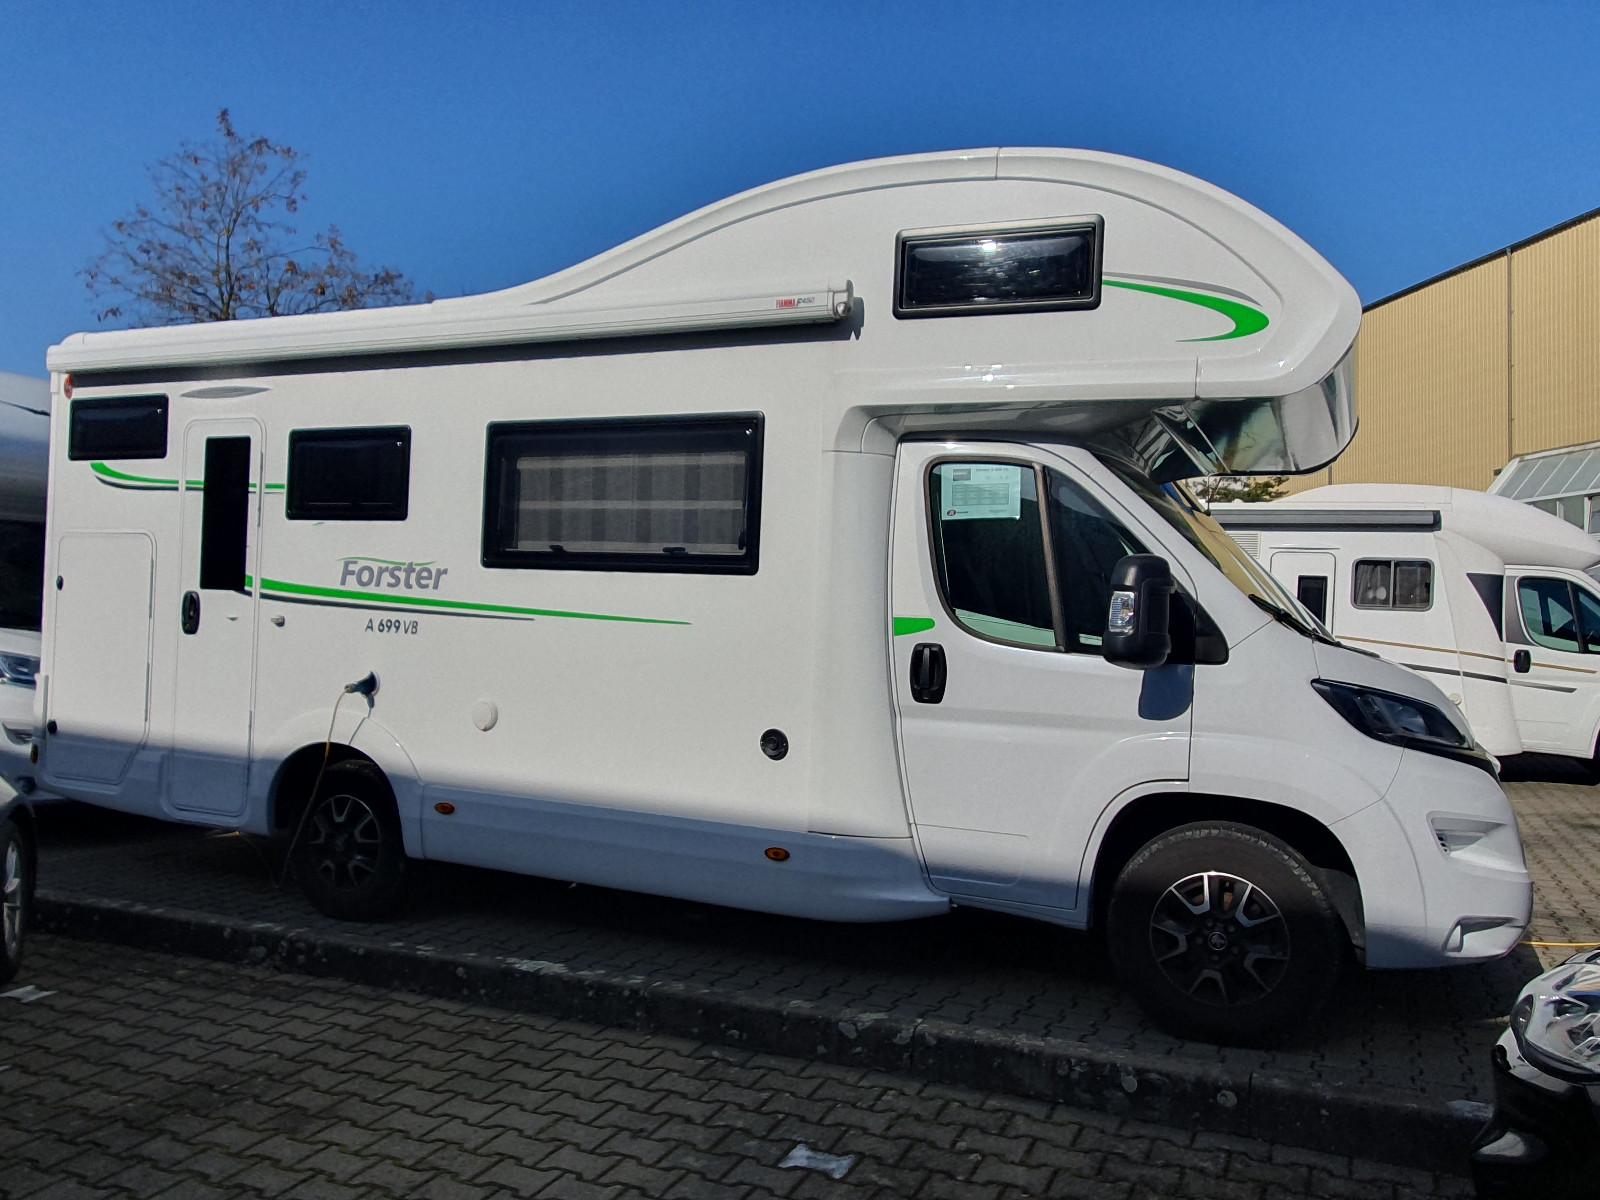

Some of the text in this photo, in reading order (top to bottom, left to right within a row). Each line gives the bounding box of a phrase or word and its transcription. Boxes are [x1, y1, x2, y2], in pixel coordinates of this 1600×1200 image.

[339, 560, 449, 590] Forster
[364, 618, 419, 635] A 699 VB
